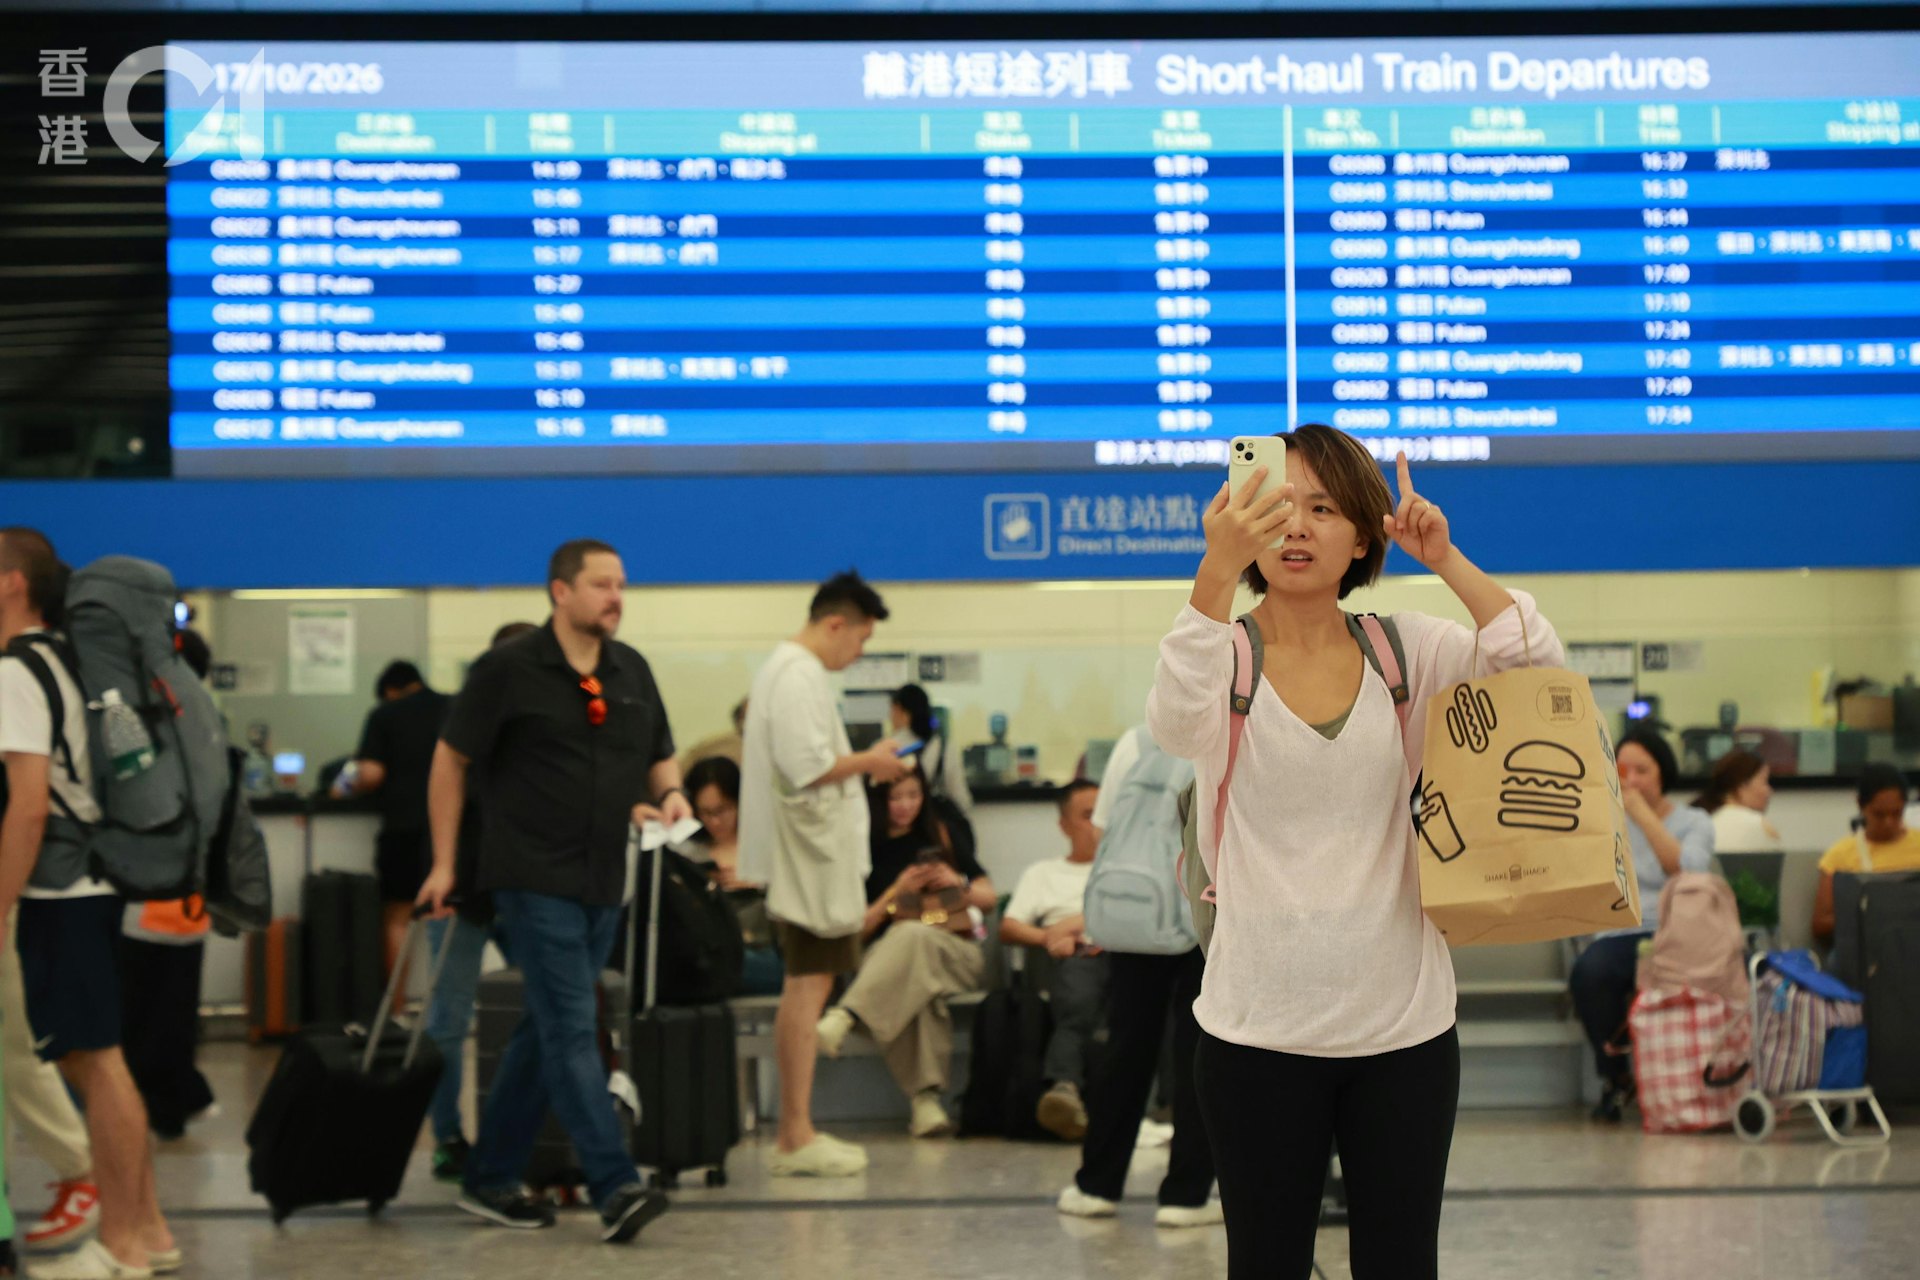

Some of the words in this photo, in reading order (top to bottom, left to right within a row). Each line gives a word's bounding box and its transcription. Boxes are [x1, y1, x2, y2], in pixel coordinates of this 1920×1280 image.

[214, 62, 384, 95] 17/10/2026
[863, 51, 1130, 97] 離港短途列車
[1156, 54, 1363, 94] Short-haul
[1373, 53, 1477, 91] Train
[1488, 52, 1711, 98] Departures
[1060, 495, 1207, 531] 直達站點
[1058, 535, 1112, 555] Direct
[1116, 535, 1207, 555] Destinatio
